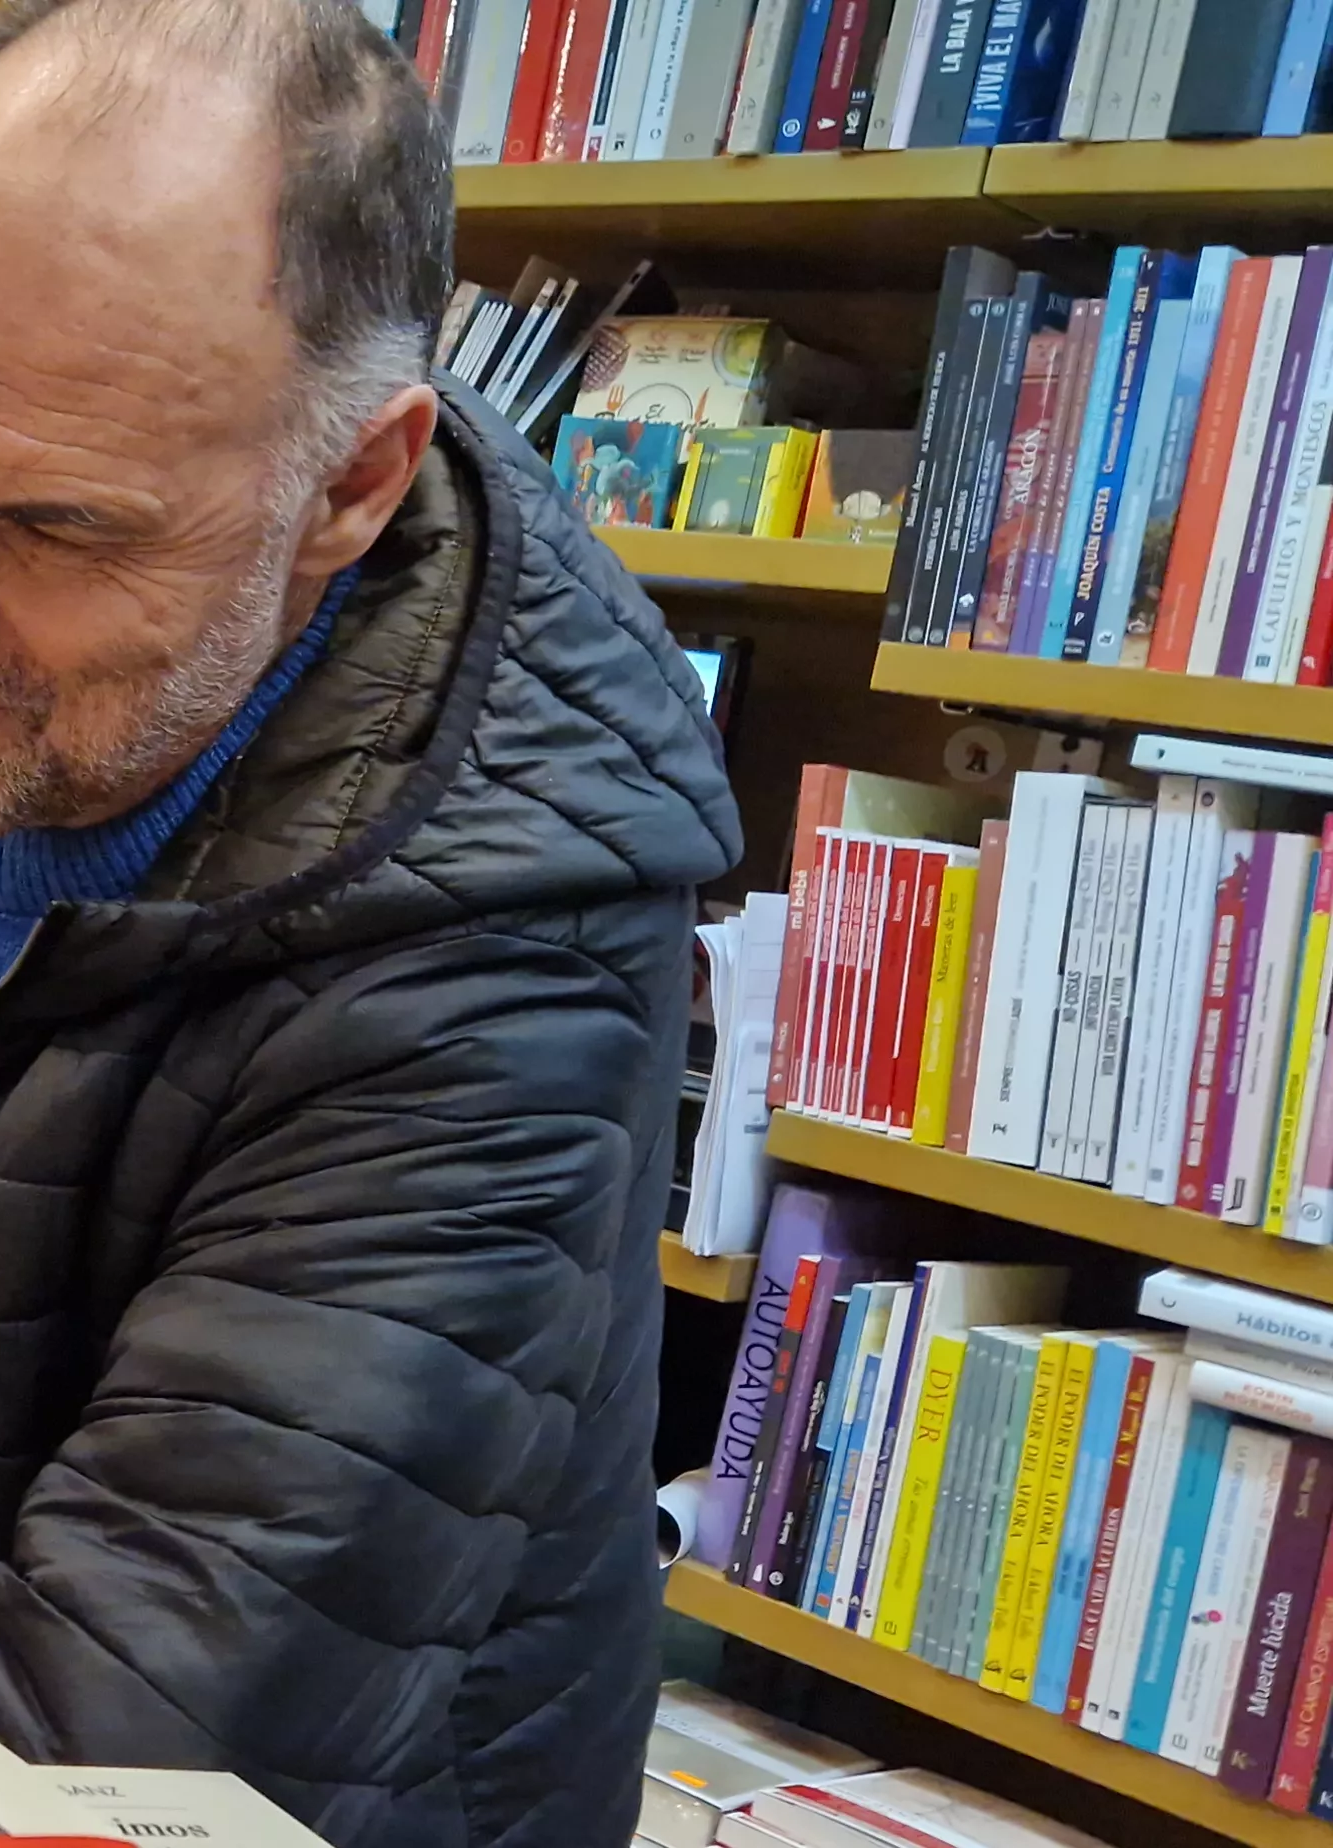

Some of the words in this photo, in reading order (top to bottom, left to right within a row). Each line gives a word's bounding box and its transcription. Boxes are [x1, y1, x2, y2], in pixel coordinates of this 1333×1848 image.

[948, 8, 972, 50] BALA
[985, 33, 1013, 56] EL
[940, 51, 960, 73] LA
[976, 60, 1007, 111] ¡VIVA
[1291, 400, 1327, 508] MONTESCOS
[1077, 534, 1102, 601] JOAQUÍN
[1090, 486, 1112, 533] COSTA
[1286, 518, 1303, 530] Y
[1261, 537, 1298, 644] CAPULETOS
[792, 870, 809, 909] bebé
[791, 911, 803, 930] mi
[1236, 1312, 1322, 1343] Hábitos
[717, 1275, 790, 1480] AUTOAYUDA
[1038, 1360, 1054, 1376] EL
[1067, 1367, 1083, 1383] EL
[916, 1367, 952, 1444] DYER
[1027, 1383, 1050, 1440] PODER
[1054, 1391, 1079, 1448] PODER
[1022, 1444, 1040, 1473] DEL
[1048, 1451, 1067, 1480] DEL
[1010, 1482, 1033, 1539] AHORA
[1035, 1490, 1059, 1547] AHORA
[1245, 1648, 1280, 1717] Muerte
[1298, 1663, 1325, 1724] CAMINO
[56, 1784, 126, 1798] SANZ
